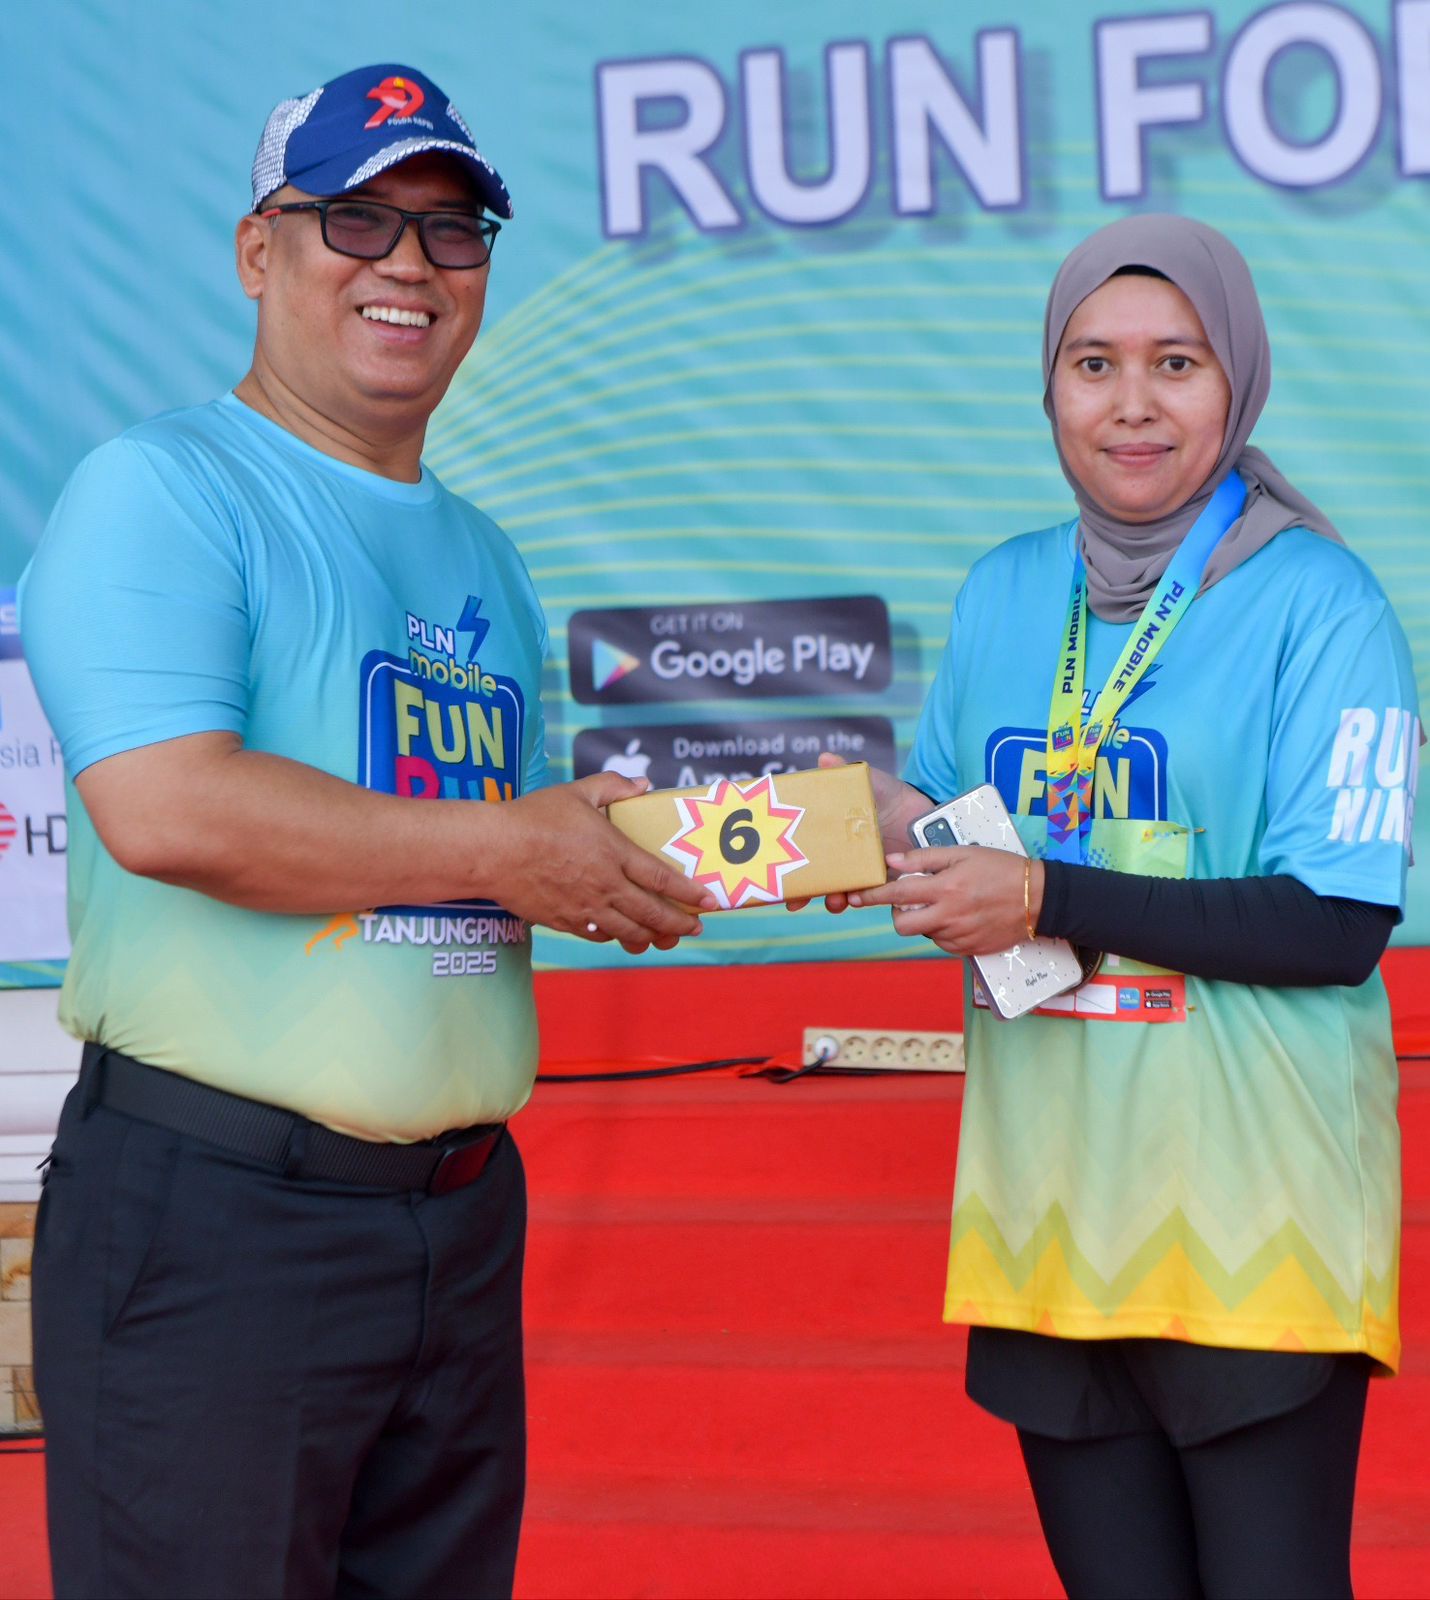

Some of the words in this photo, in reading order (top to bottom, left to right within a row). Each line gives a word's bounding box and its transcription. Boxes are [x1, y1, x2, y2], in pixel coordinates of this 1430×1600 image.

[596, 28, 1022, 239] RUN
[650, 613, 688, 635] GET
[690, 612, 707, 632] IT
[710, 610, 744, 632] ON
[1067, 582, 1083, 652] MOBILE
[1154, 579, 1186, 623] PLN
[405, 611, 456, 656] PLN
[1112, 621, 1161, 693] MOBILE
[408, 648, 498, 698] mobile
[650, 637, 786, 686] Google
[792, 634, 875, 680] Play
[1061, 657, 1077, 694] PLN
[393, 677, 506, 770] FUN
[673, 735, 786, 759] Download
[791, 736, 821, 754] on
[827, 731, 866, 752] the
[1326, 707, 1419, 789] RU
[0, 739, 40, 770] sia
[1016, 747, 1131, 819] FN
[718, 807, 762, 865] 6
[432, 950, 498, 976] 2025
